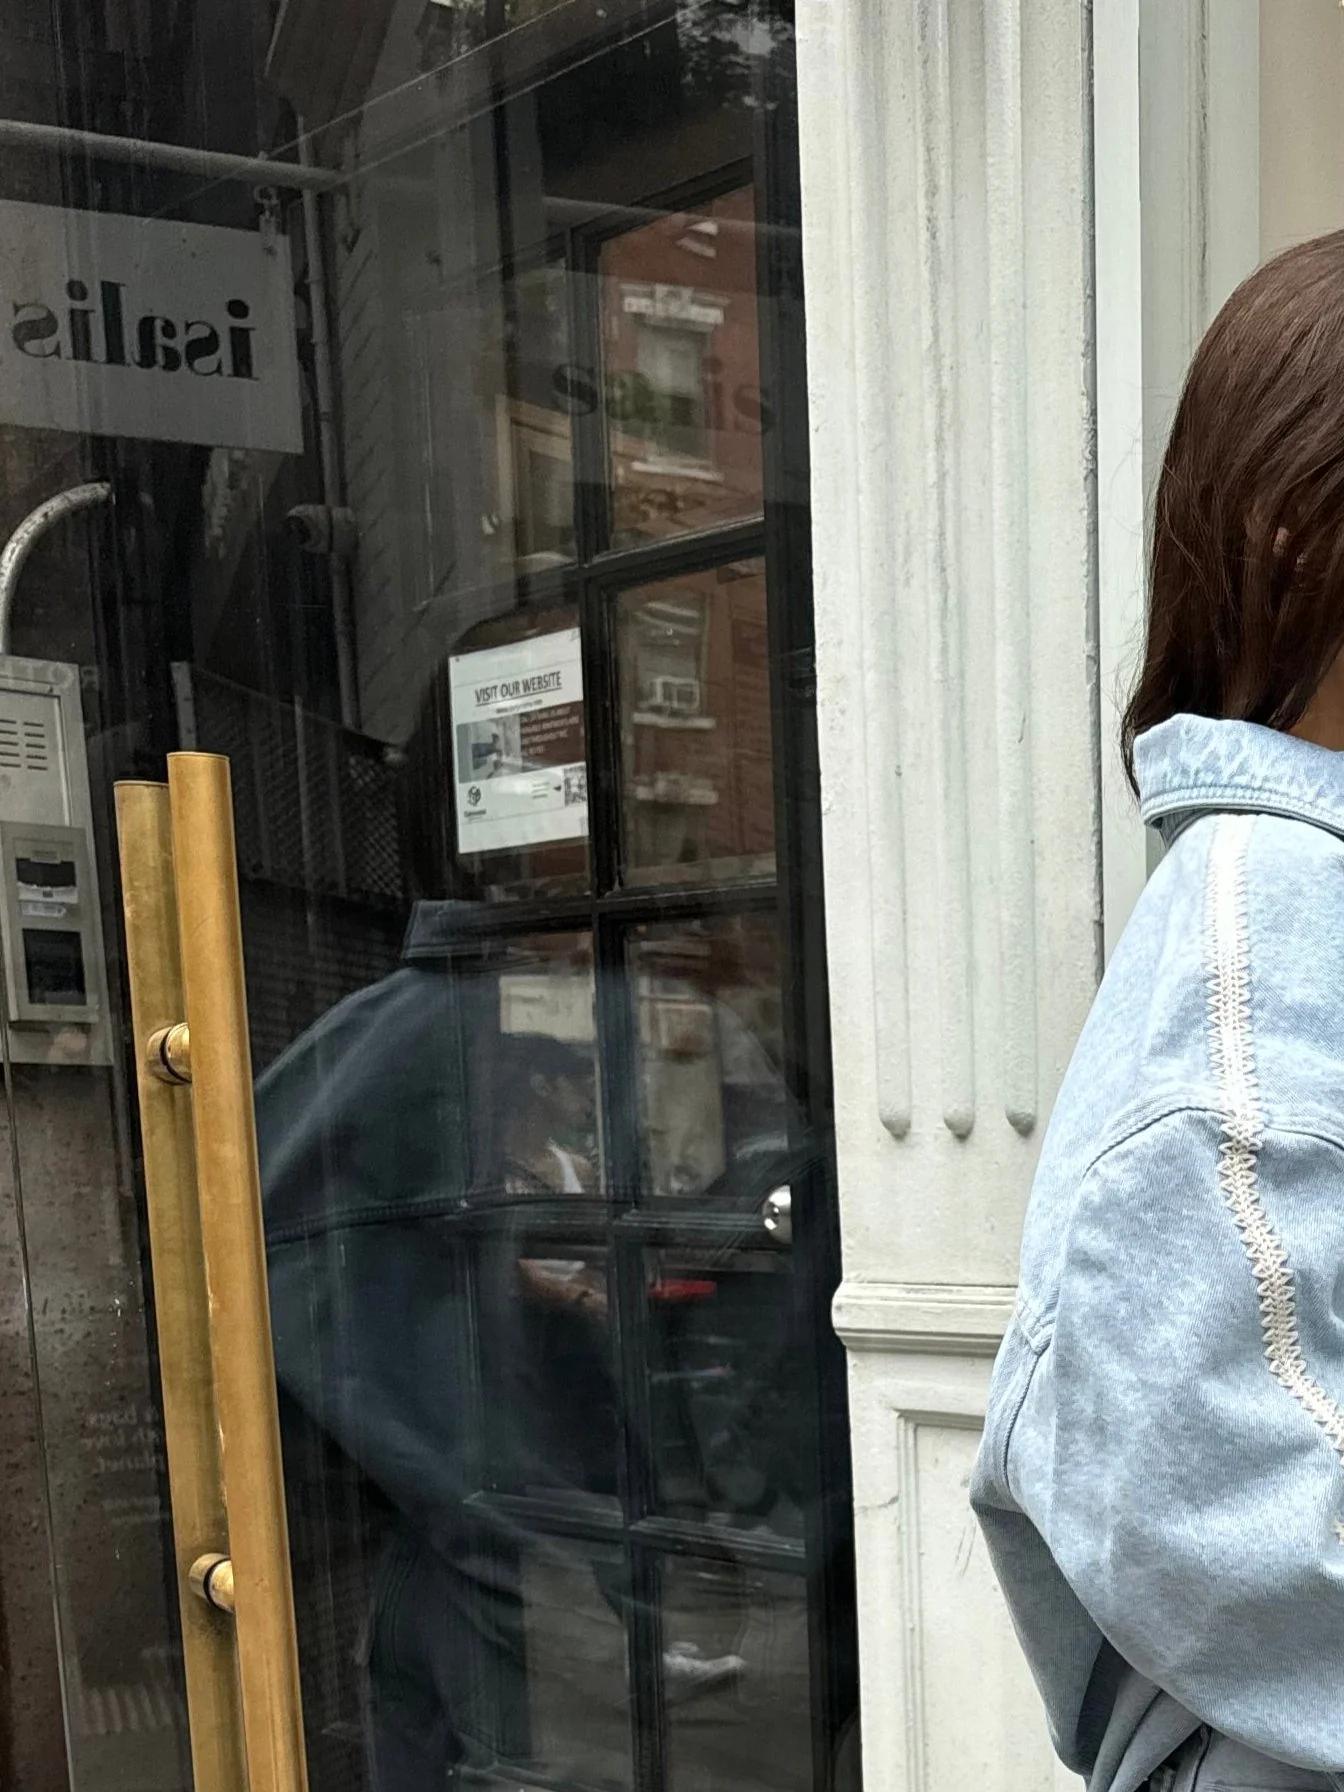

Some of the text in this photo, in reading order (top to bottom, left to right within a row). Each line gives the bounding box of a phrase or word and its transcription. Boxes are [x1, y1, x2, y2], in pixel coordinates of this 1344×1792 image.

[475, 671, 562, 703] VISIT OUR WEBSITE
